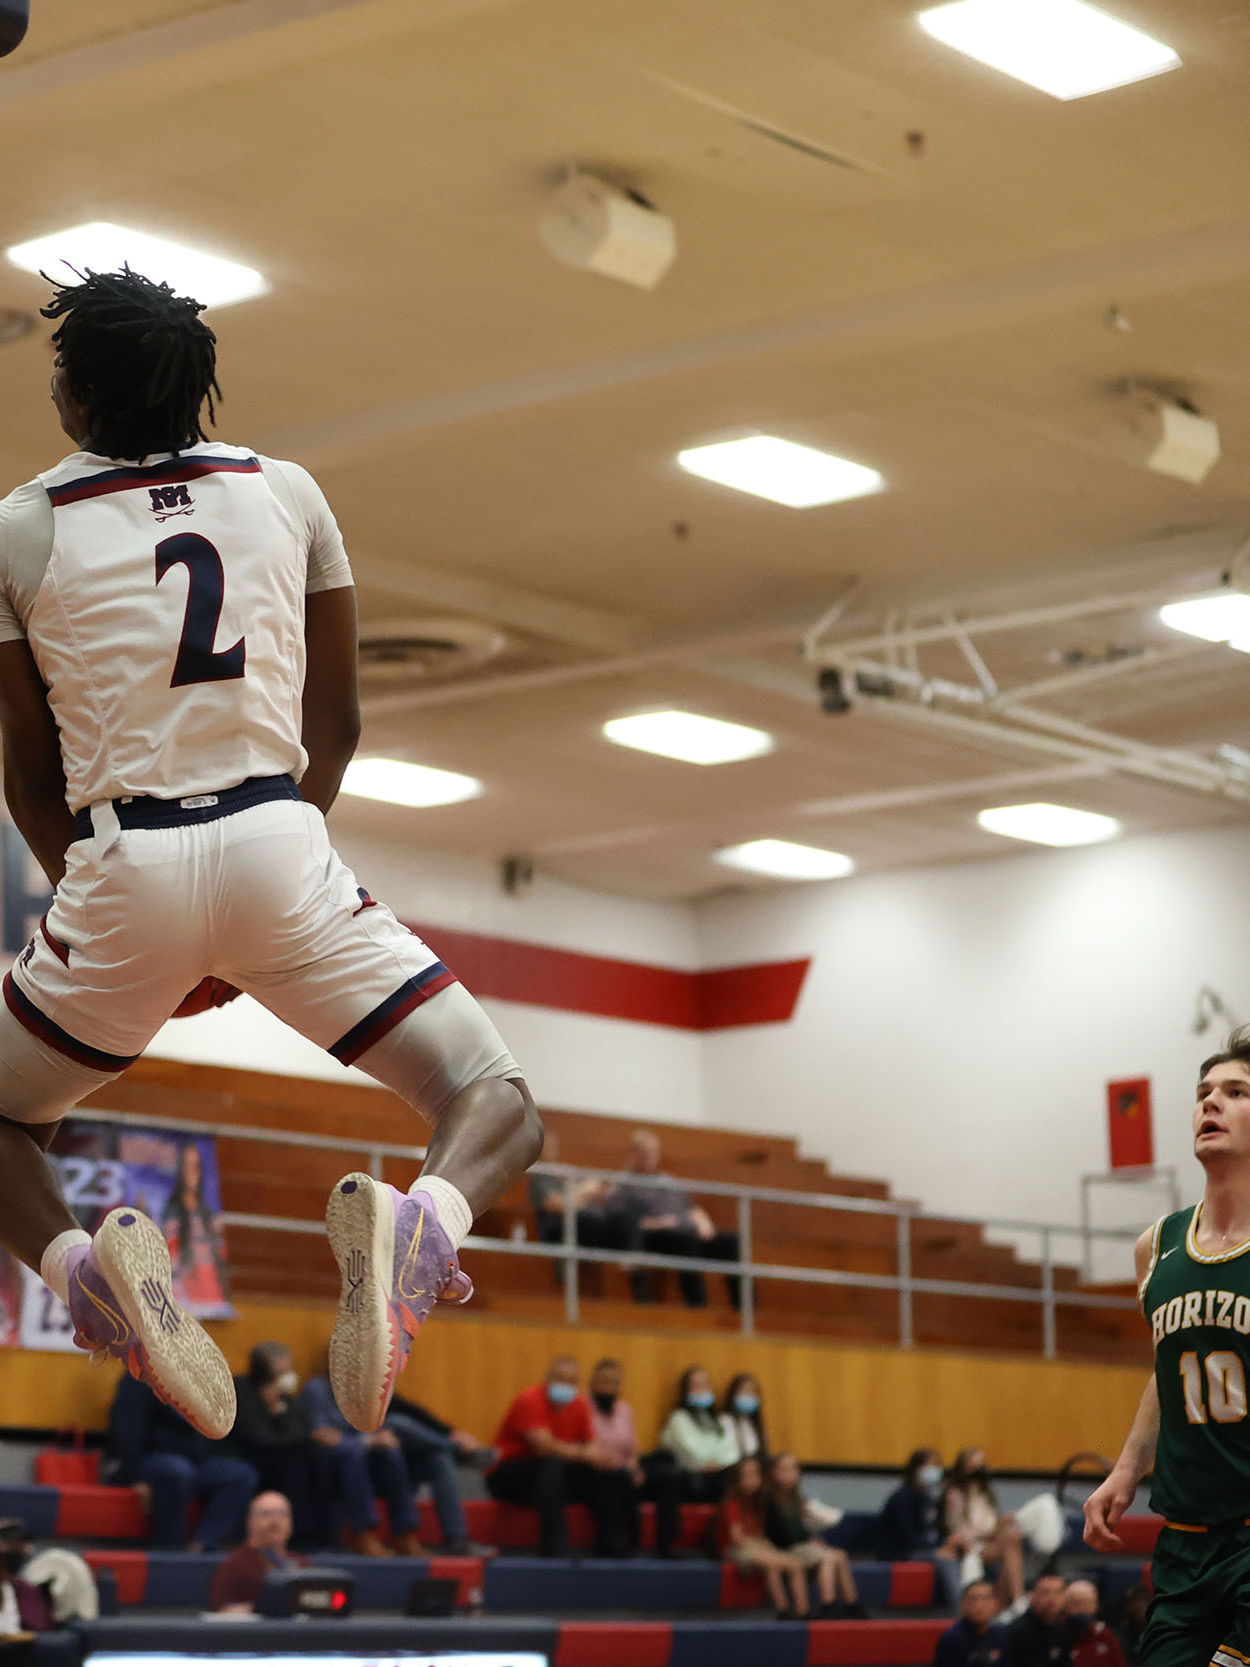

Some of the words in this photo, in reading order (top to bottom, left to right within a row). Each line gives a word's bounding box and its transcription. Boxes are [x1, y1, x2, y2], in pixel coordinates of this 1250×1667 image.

[155, 532, 246, 688] 2
[61, 1156, 124, 1206] 23
[1152, 1289, 1250, 1347] HORIZO
[1179, 1350, 1248, 1424] 10
